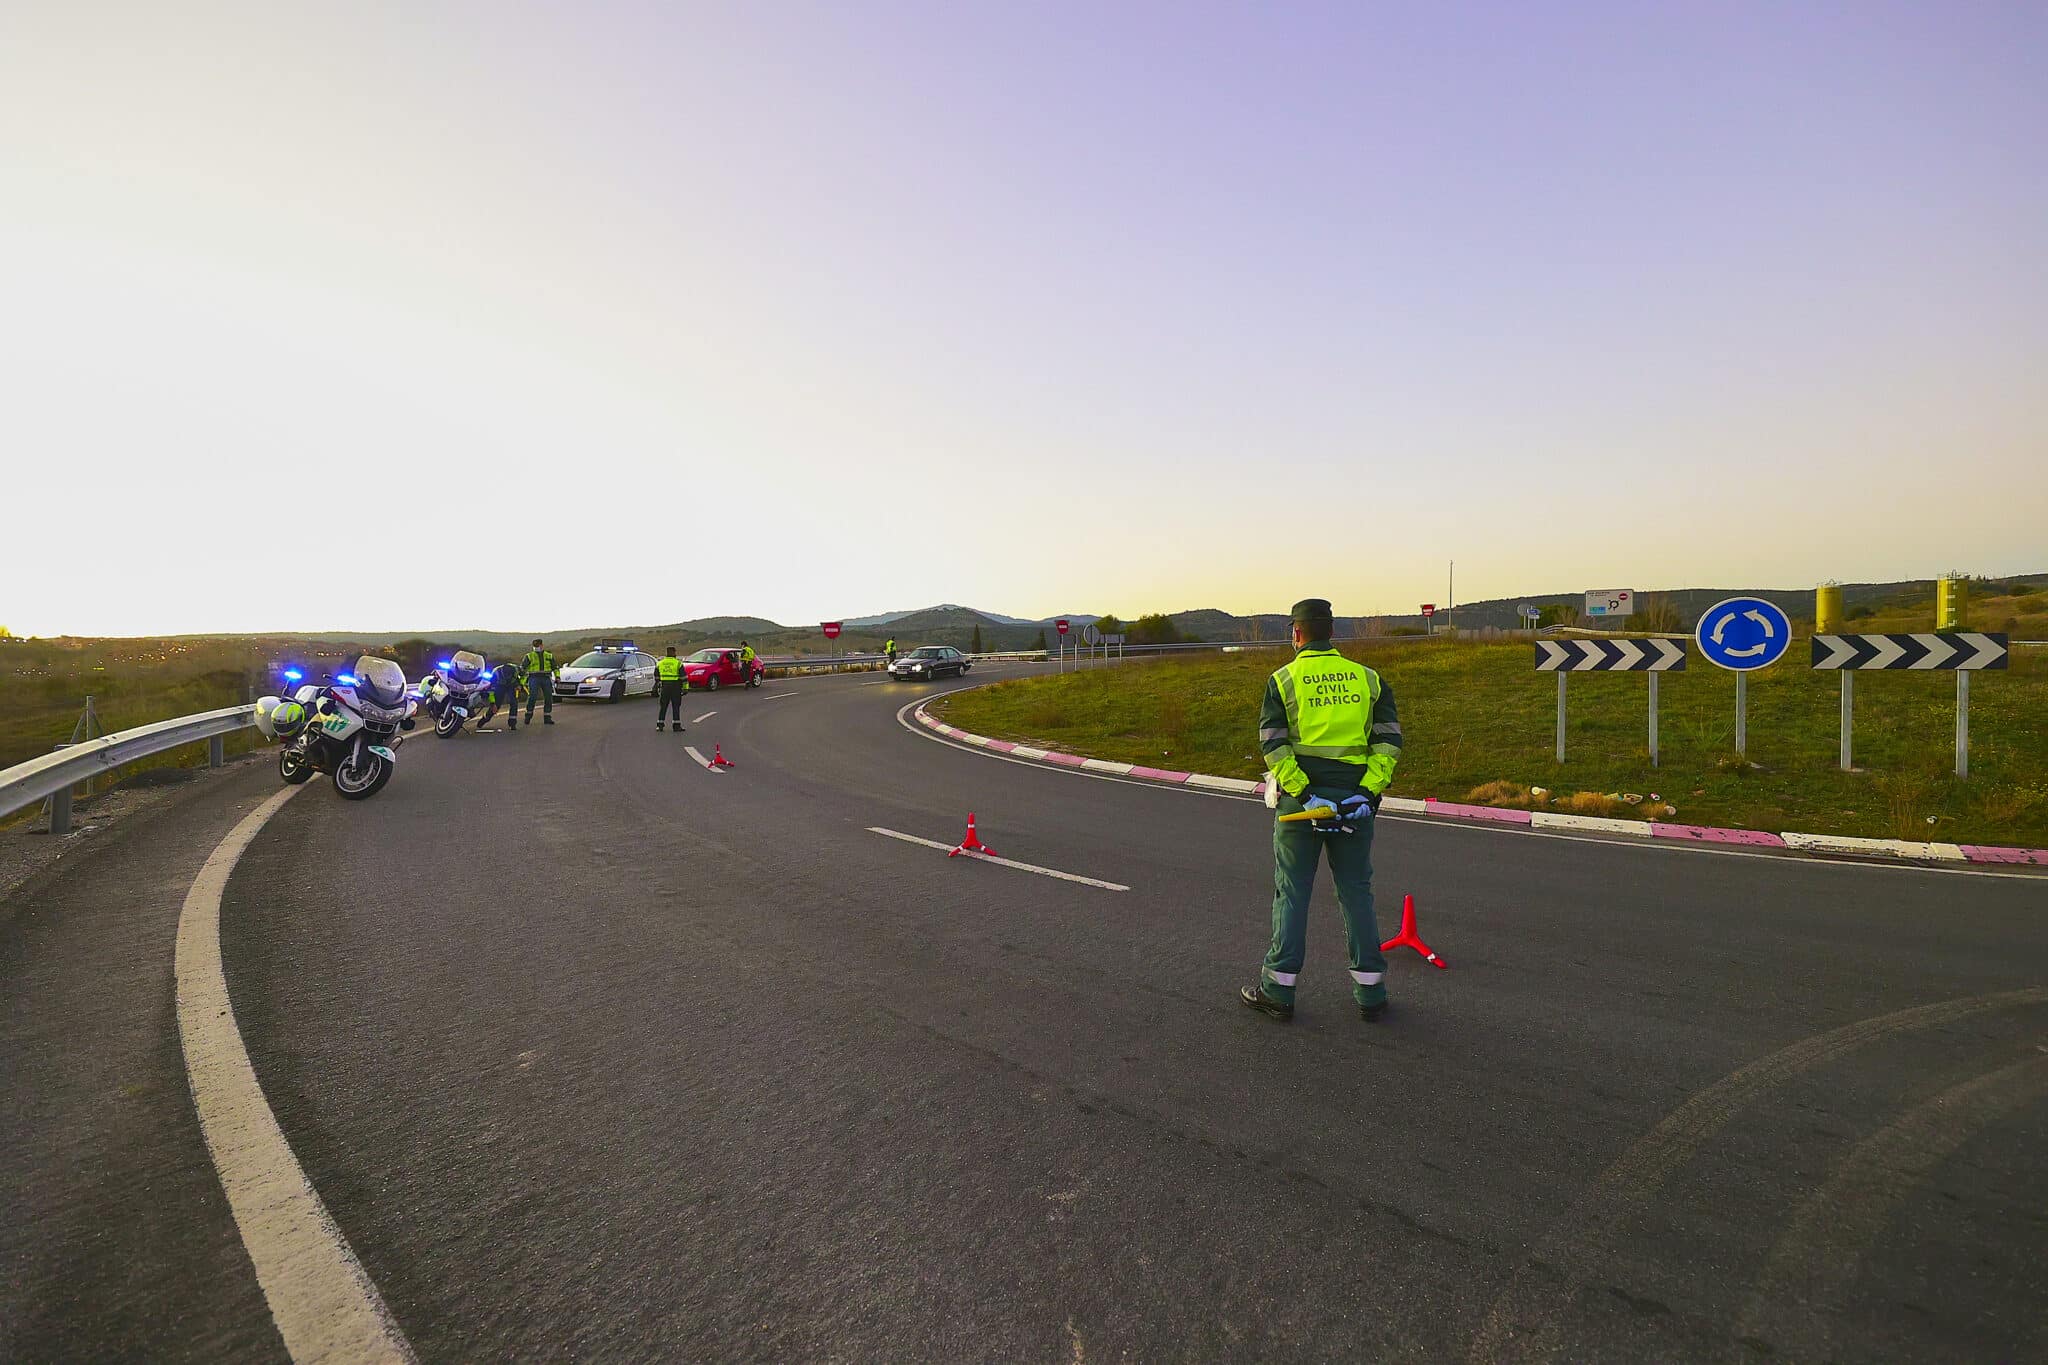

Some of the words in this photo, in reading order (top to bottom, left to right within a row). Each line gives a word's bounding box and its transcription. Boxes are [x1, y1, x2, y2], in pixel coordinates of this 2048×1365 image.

[1303, 672, 1358, 684] GUARDIA
[1316, 684, 1349, 694] CIVIL
[1308, 694, 1360, 707] TRAFICO
